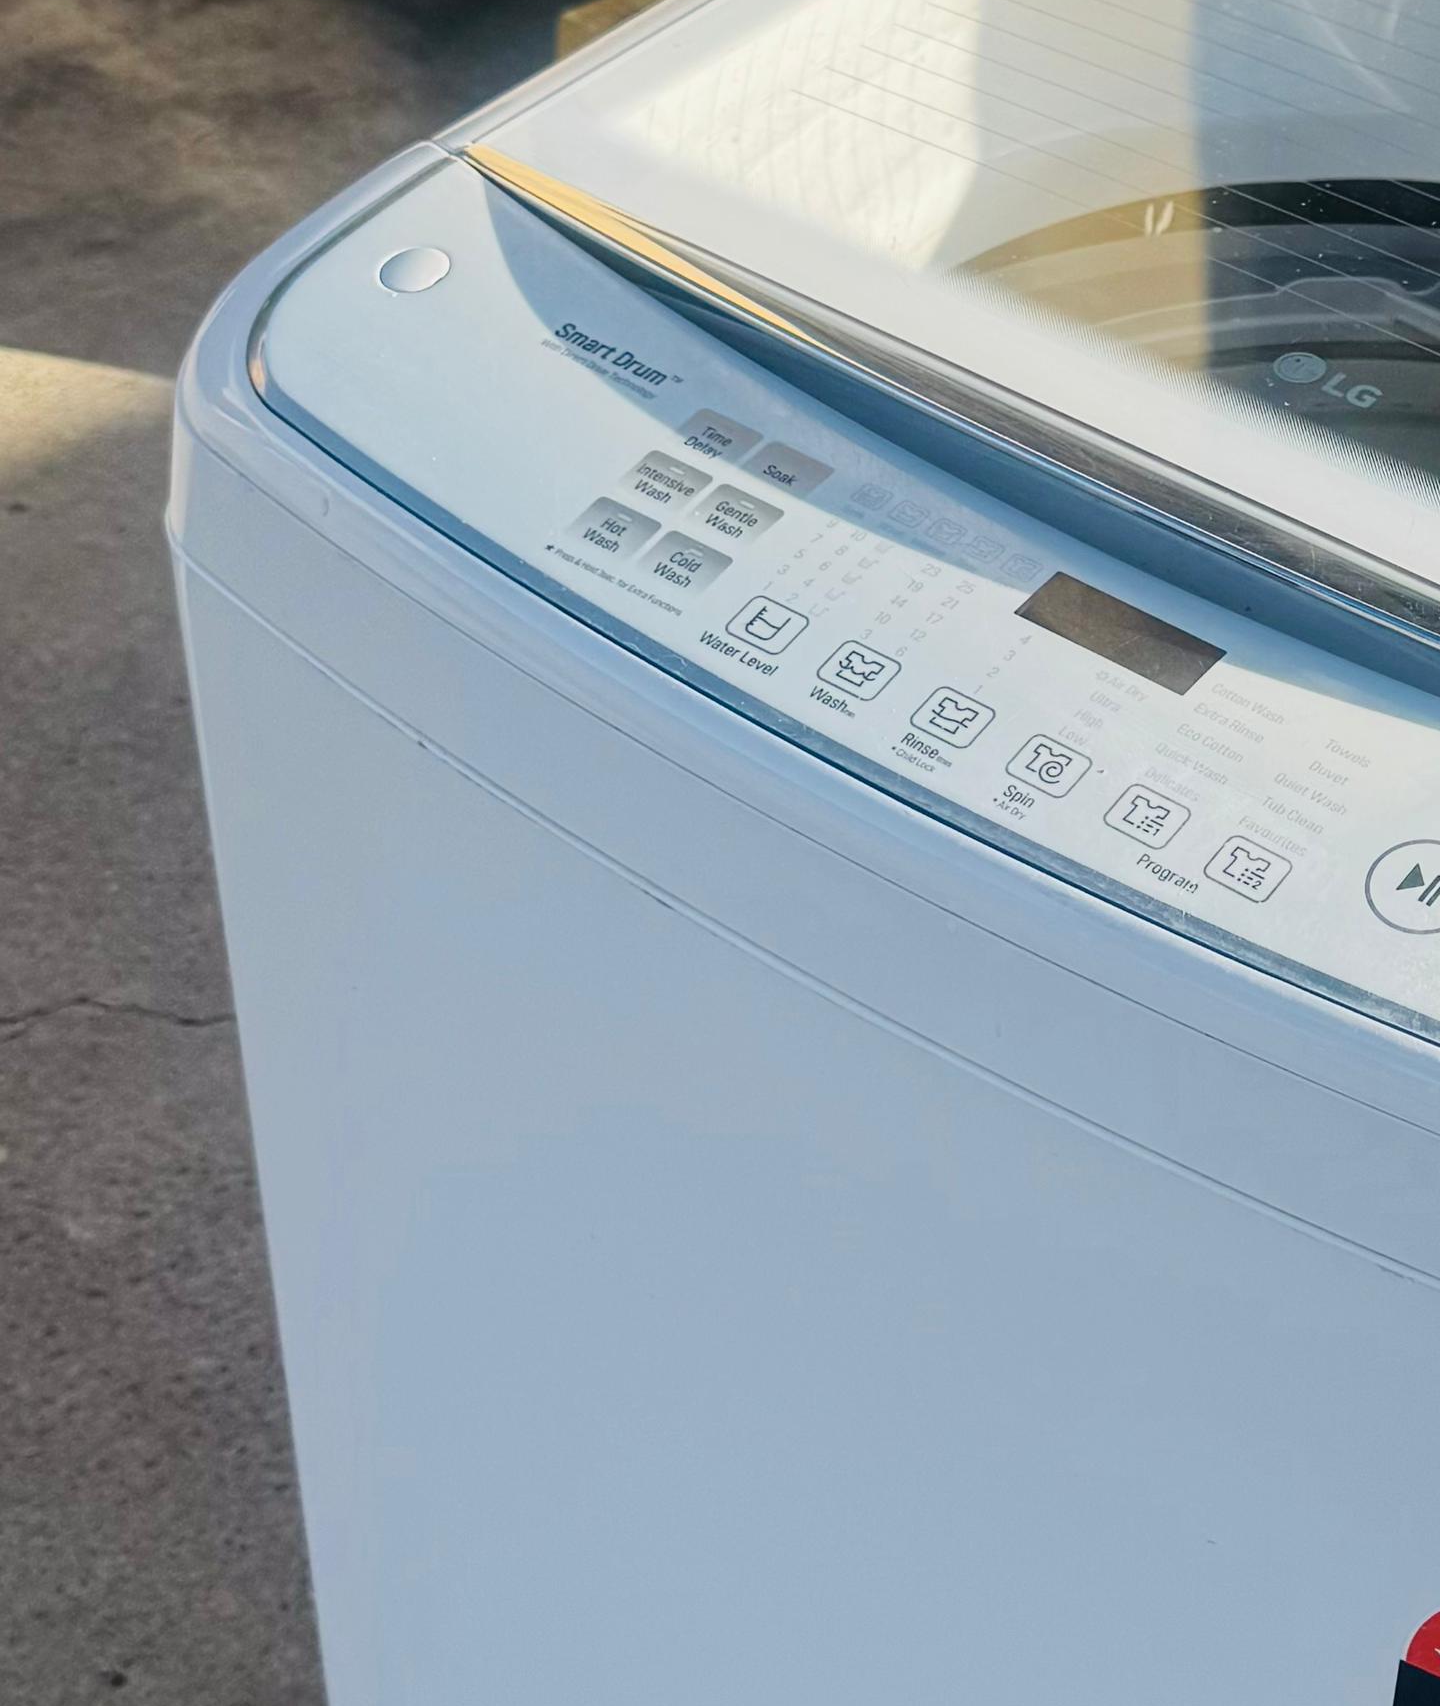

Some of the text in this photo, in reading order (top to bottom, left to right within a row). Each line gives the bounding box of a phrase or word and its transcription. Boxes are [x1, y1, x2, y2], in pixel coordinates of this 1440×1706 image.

[554, 322, 617, 360] Smart
[1321, 372, 1383, 408] LG
[684, 435, 724, 460] Delay
[702, 426, 733, 447] Time
[636, 463, 695, 498] Intensive
[762, 464, 799, 487] Soak
[633, 478, 672, 504] Wash
[704, 514, 744, 539] Wash
[715, 499, 759, 528] Gentle
[582, 527, 620, 554] Wash
[600, 517, 627, 538] Hot
[653, 562, 692, 589] Wash
[669, 551, 703, 574] Cold
[700, 630, 780, 678] Water Level
[810, 685, 848, 712] Wash
[1193, 702, 1266, 744] Extra Rinse
[1250, 701, 1285, 725] Wash
[900, 732, 939, 759] Rinse
[1176, 723, 1245, 764] Eco Cotton
[1324, 738, 1371, 768] Towels
[1155, 742, 1229, 786] Quick Wash
[1308, 760, 1349, 786] Duvet
[1003, 784, 1035, 809] Spin
[1274, 772, 1348, 816] Quiet Wash
[1262, 796, 1325, 835] Tub Clean
[1238, 815, 1308, 857] Favourites
[1136, 853, 1199, 894] Program
